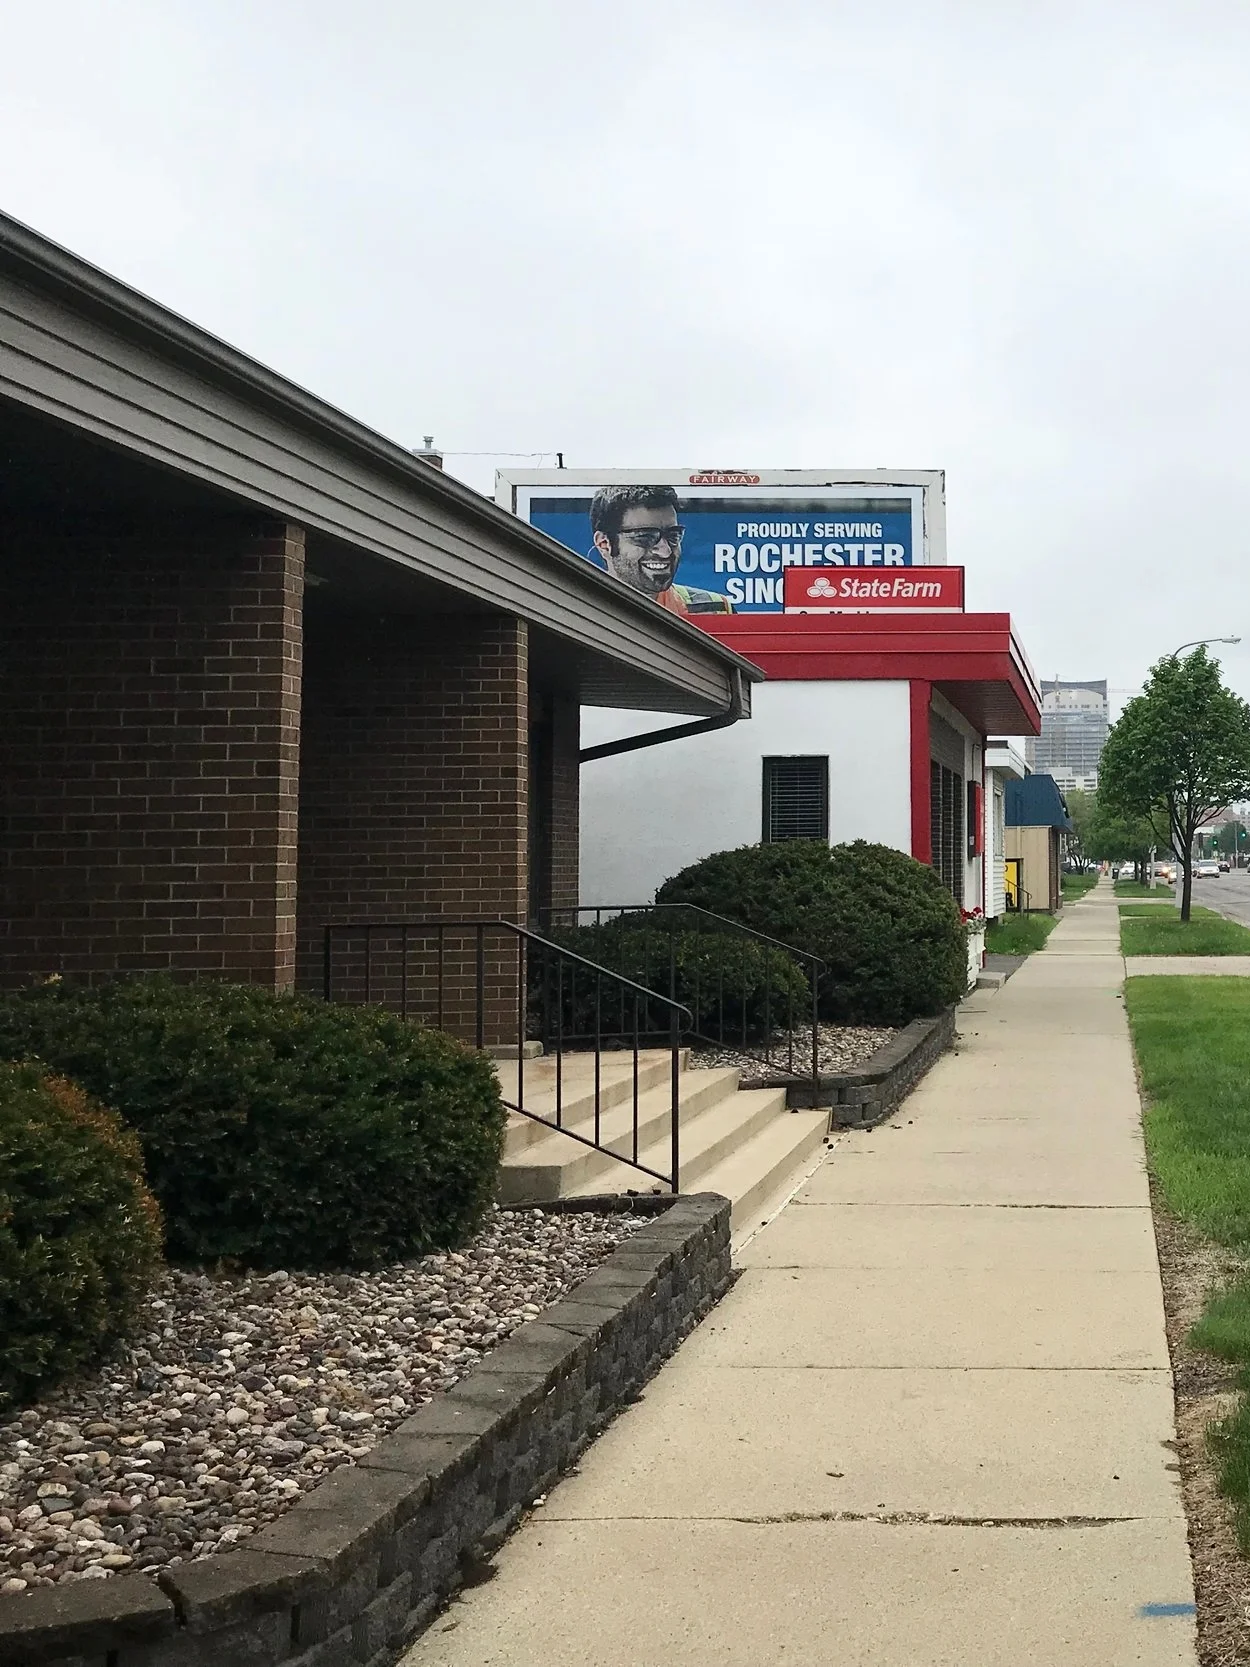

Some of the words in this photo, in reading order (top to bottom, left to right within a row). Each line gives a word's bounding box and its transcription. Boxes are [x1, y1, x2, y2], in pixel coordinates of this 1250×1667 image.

[693, 475, 756, 483] FAIRWAY
[737, 523, 809, 538] PROUDLY
[814, 523, 882, 538] SERVING
[714, 543, 905, 573] ROCHESTER
